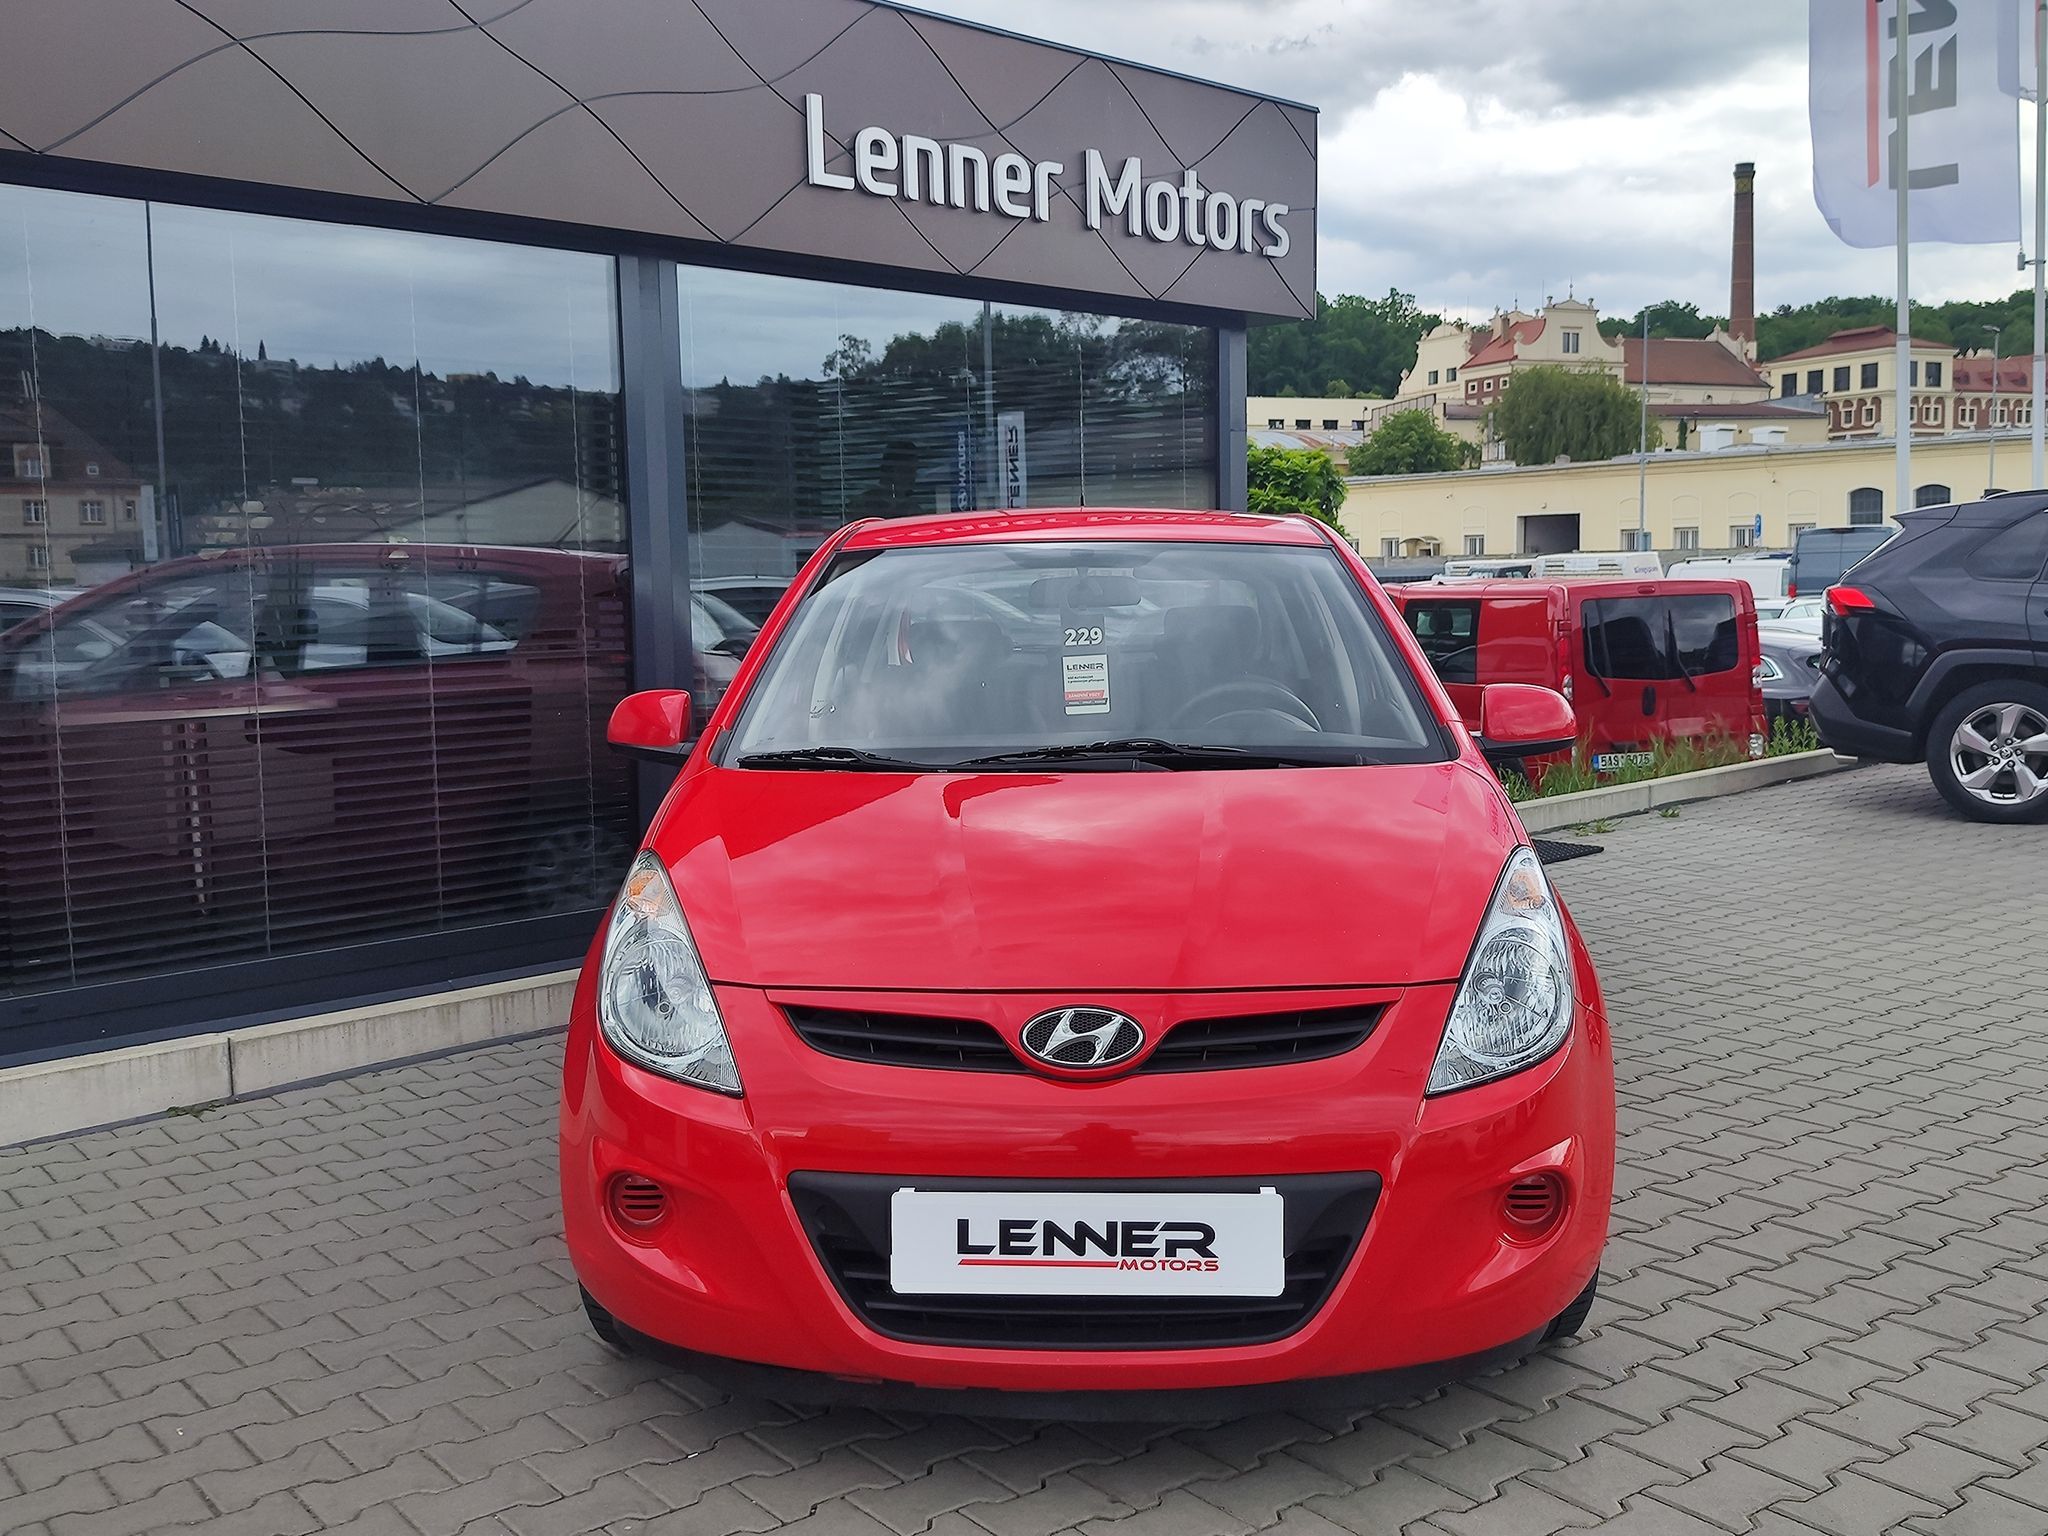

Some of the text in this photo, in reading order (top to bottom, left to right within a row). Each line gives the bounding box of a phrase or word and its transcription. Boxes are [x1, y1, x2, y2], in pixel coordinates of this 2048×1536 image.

[805, 93, 1291, 259] Lenner Motors
[1064, 626, 1103, 647] 229
[1066, 662, 1104, 671] LENNER
[956, 1218, 1219, 1259] LENNER
[1118, 1257, 1220, 1272] MOTORS
